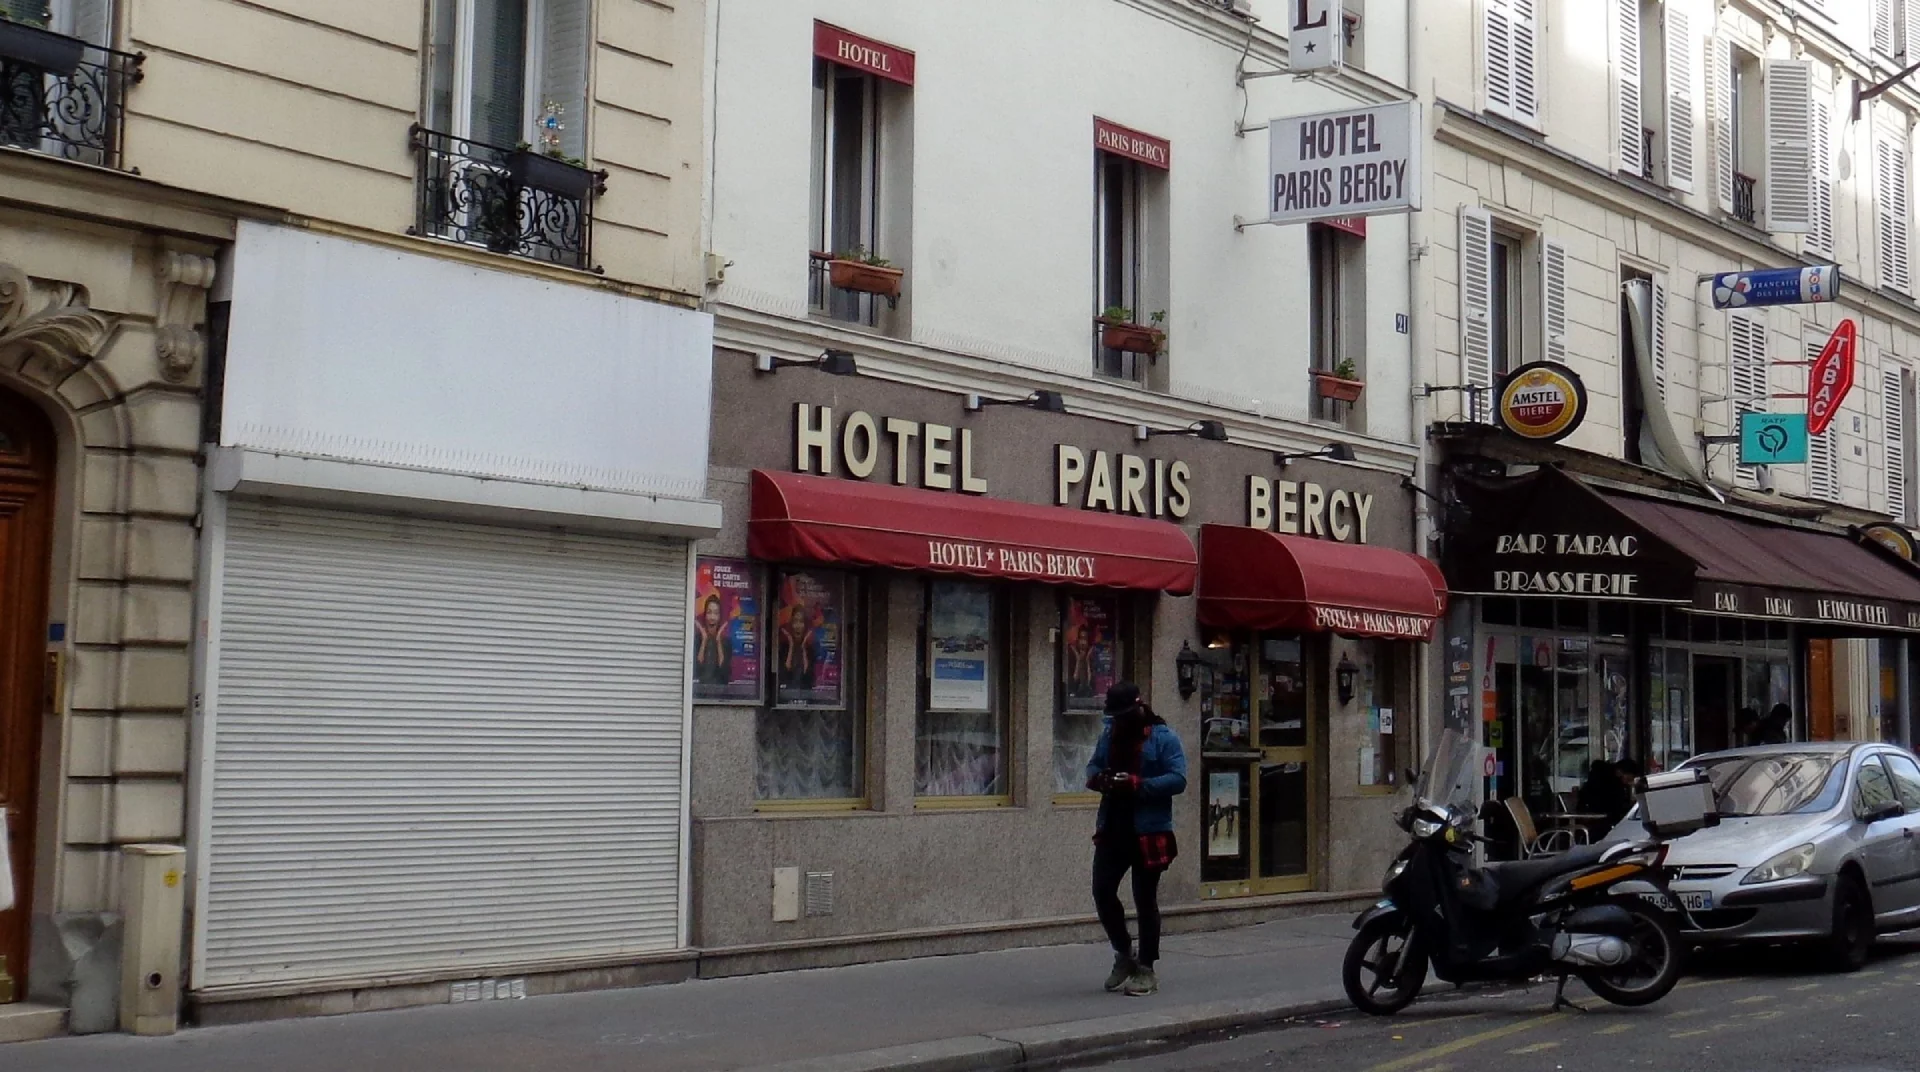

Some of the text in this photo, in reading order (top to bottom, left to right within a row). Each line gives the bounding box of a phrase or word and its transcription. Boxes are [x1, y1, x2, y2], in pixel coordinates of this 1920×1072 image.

[837, 39, 891, 73] HOTEL
[1099, 128, 1166, 164] PARIS BERCY
[1300, 114, 1381, 160] HOTEL
[1274, 159, 1407, 212] PARIS BERCY
[1397, 314, 1408, 333] 21
[1813, 336, 1849, 417] TABAC
[1512, 391, 1562, 405] AMSTEL
[798, 402, 1374, 543] HOTEL PARIS BERCY
[928, 541, 1095, 579] HOTEL PARIS BERCY
[1496, 533, 1638, 557] BAR TABAC
[1494, 570, 1638, 596] BRASSERIE
[1315, 606, 1432, 637] HOTEL PARIS BERCY
[1715, 592, 1738, 612] BAR
[1764, 597, 1795, 616] TABAC
[1817, 599, 1831, 619] LE
